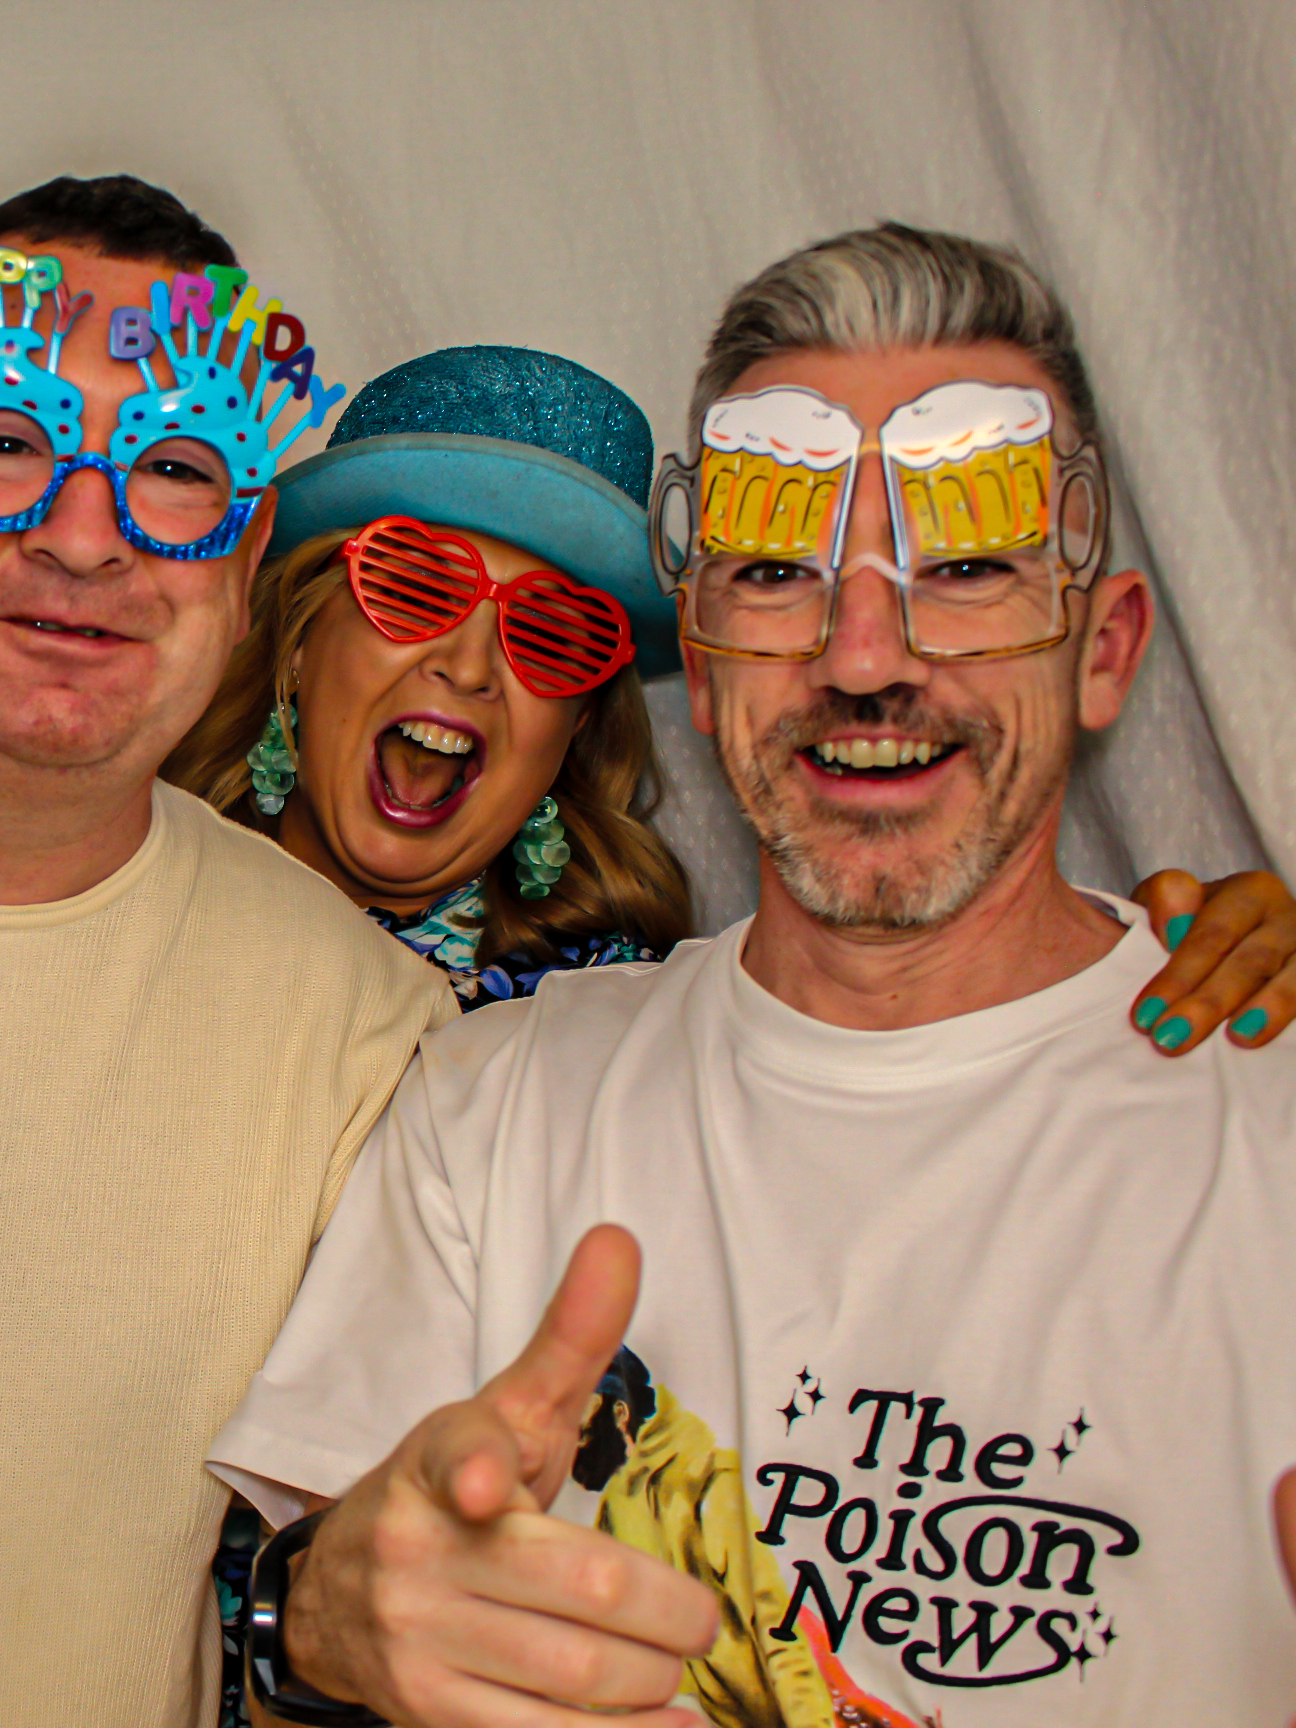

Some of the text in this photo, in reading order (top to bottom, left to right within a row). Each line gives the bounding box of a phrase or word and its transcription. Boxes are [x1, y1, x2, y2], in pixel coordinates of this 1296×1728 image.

[109, 264, 347, 428] BIRTHDAY
[847, 1388, 1035, 1490] The
[754, 1462, 1140, 1596] Poison
[768, 1559, 1080, 1688] News
